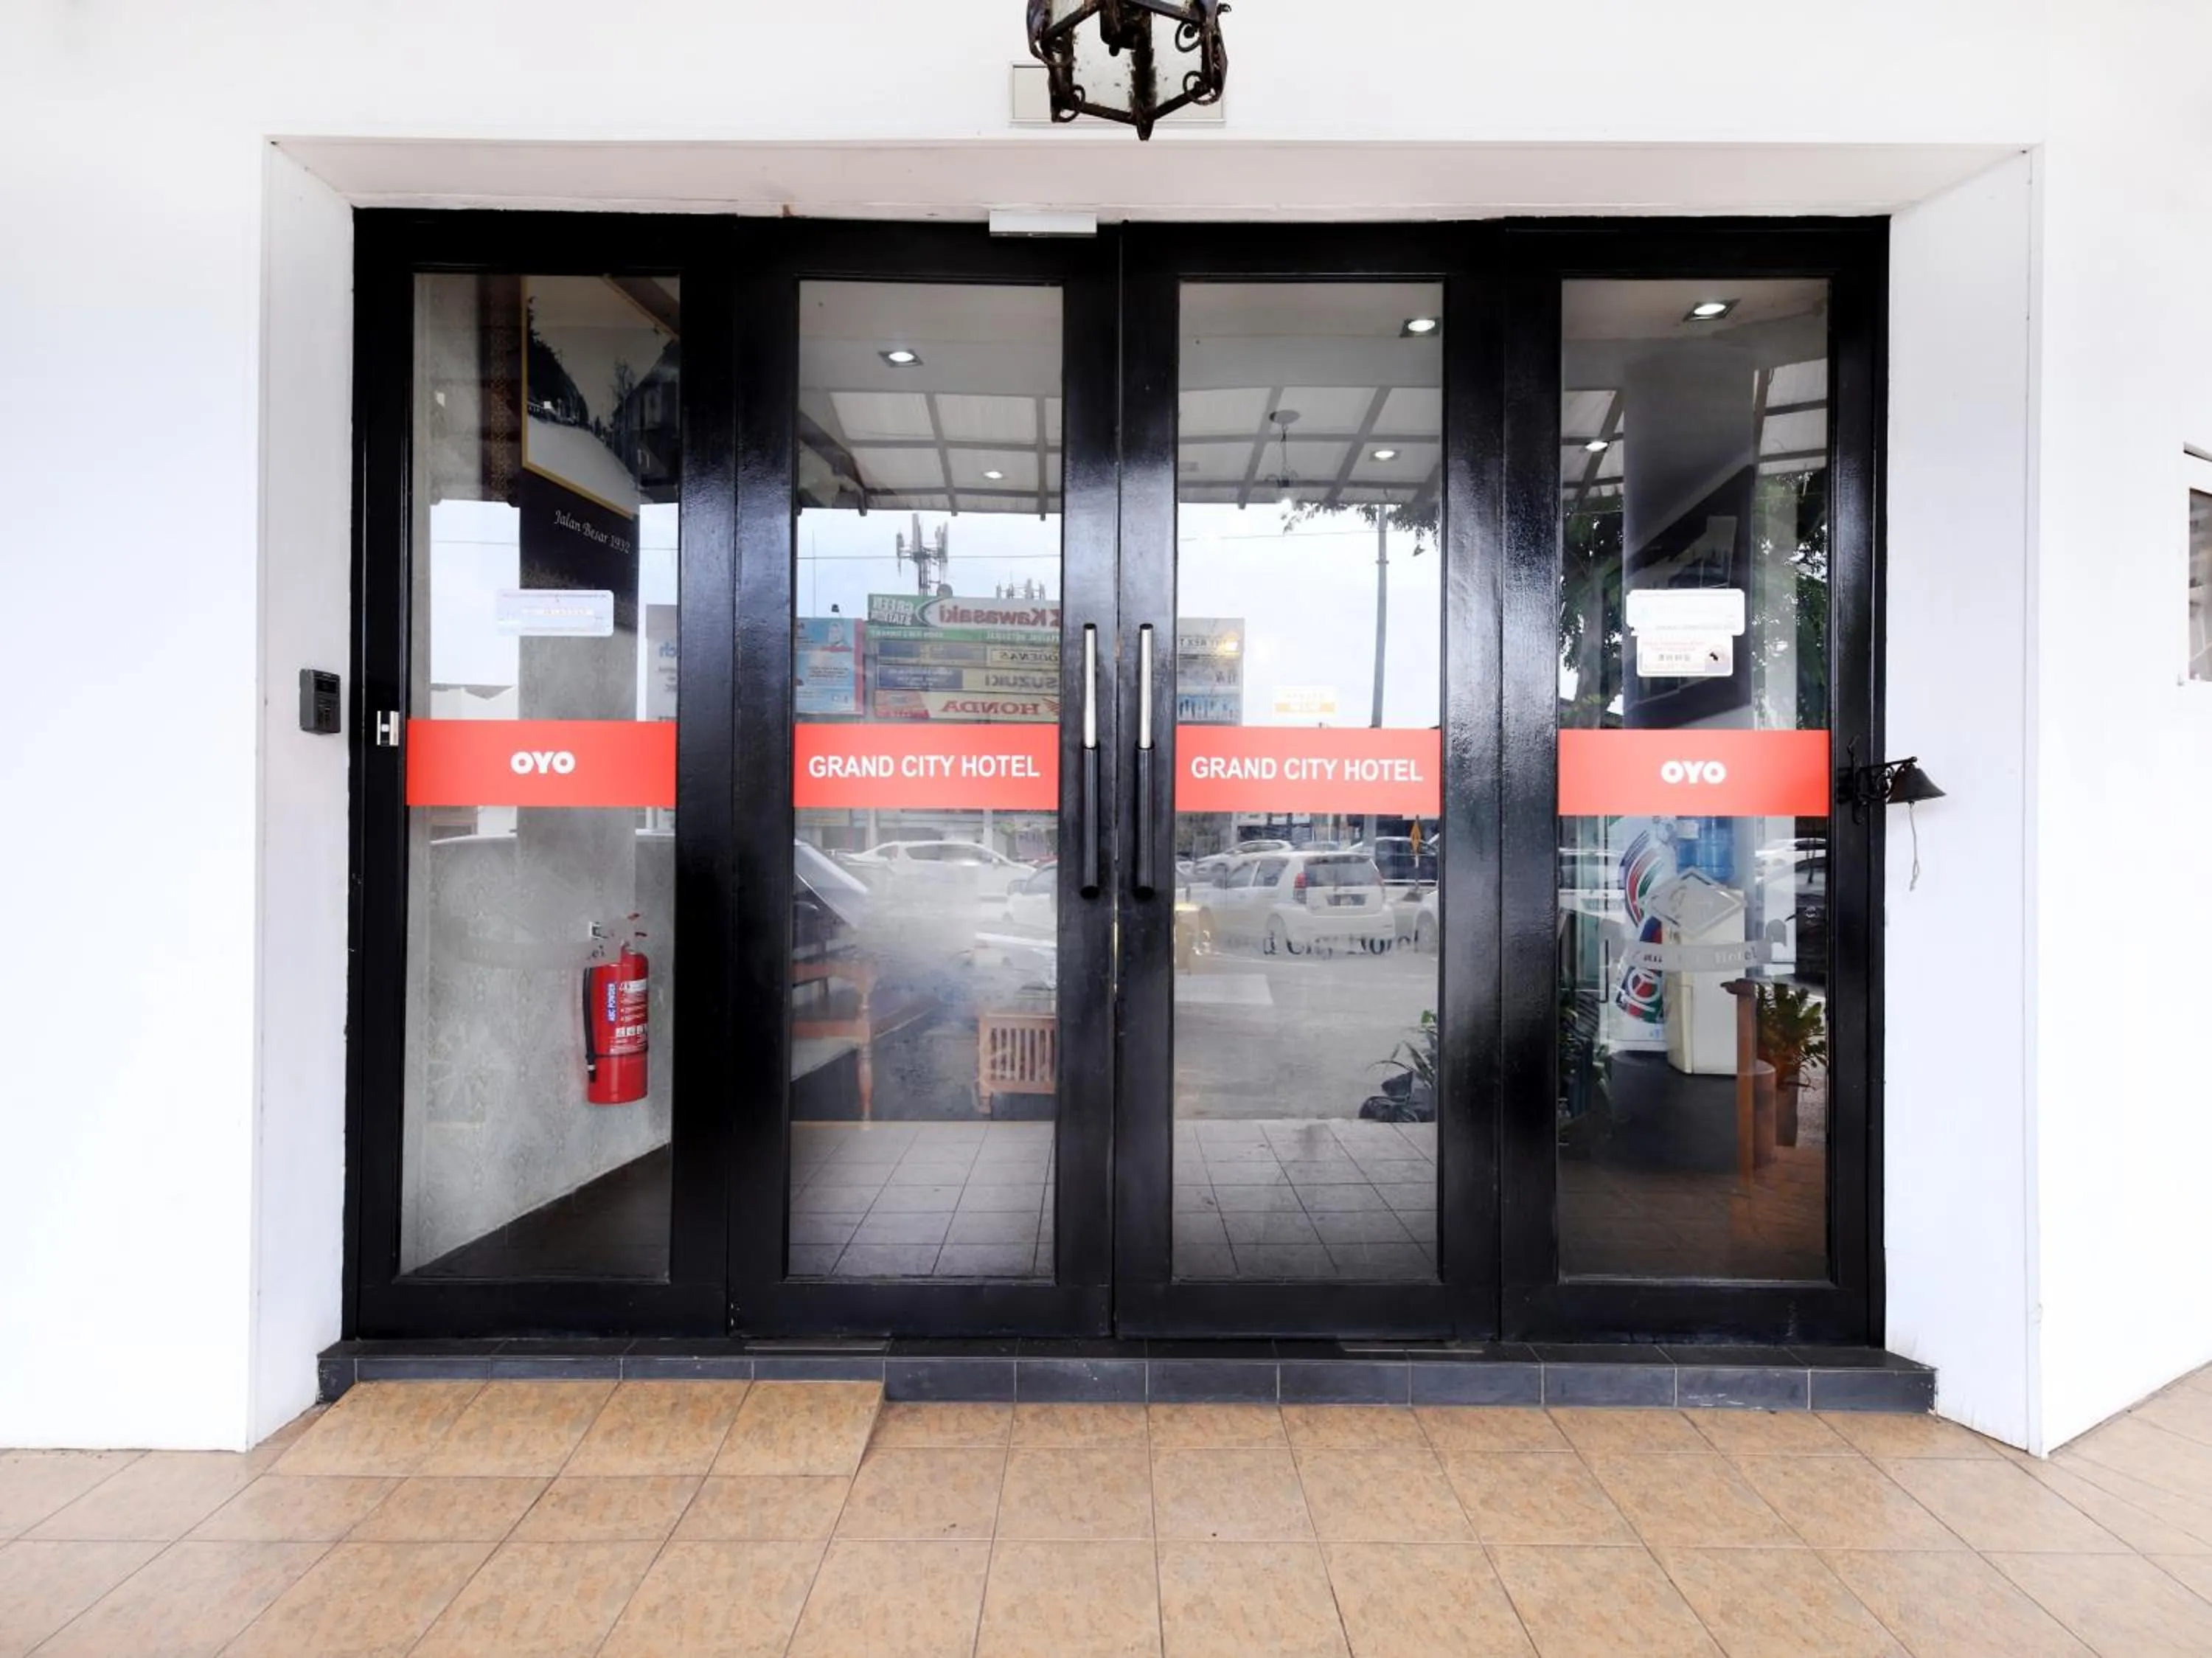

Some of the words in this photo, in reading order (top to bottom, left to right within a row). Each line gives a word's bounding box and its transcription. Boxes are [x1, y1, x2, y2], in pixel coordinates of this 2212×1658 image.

[554, 509, 580, 532] Jalan
[582, 521, 608, 544] Besar
[610, 535, 630, 554] 1932
[511, 752, 575, 774] OYO
[809, 755, 894, 779] GRAND
[901, 755, 954, 779] CITY
[961, 755, 1040, 779] HOTEL
[1191, 756, 1277, 780] GRAND
[1284, 757, 1338, 780] CITY
[1344, 759, 1423, 782] HOTEL
[1660, 760, 1727, 785] OYO
